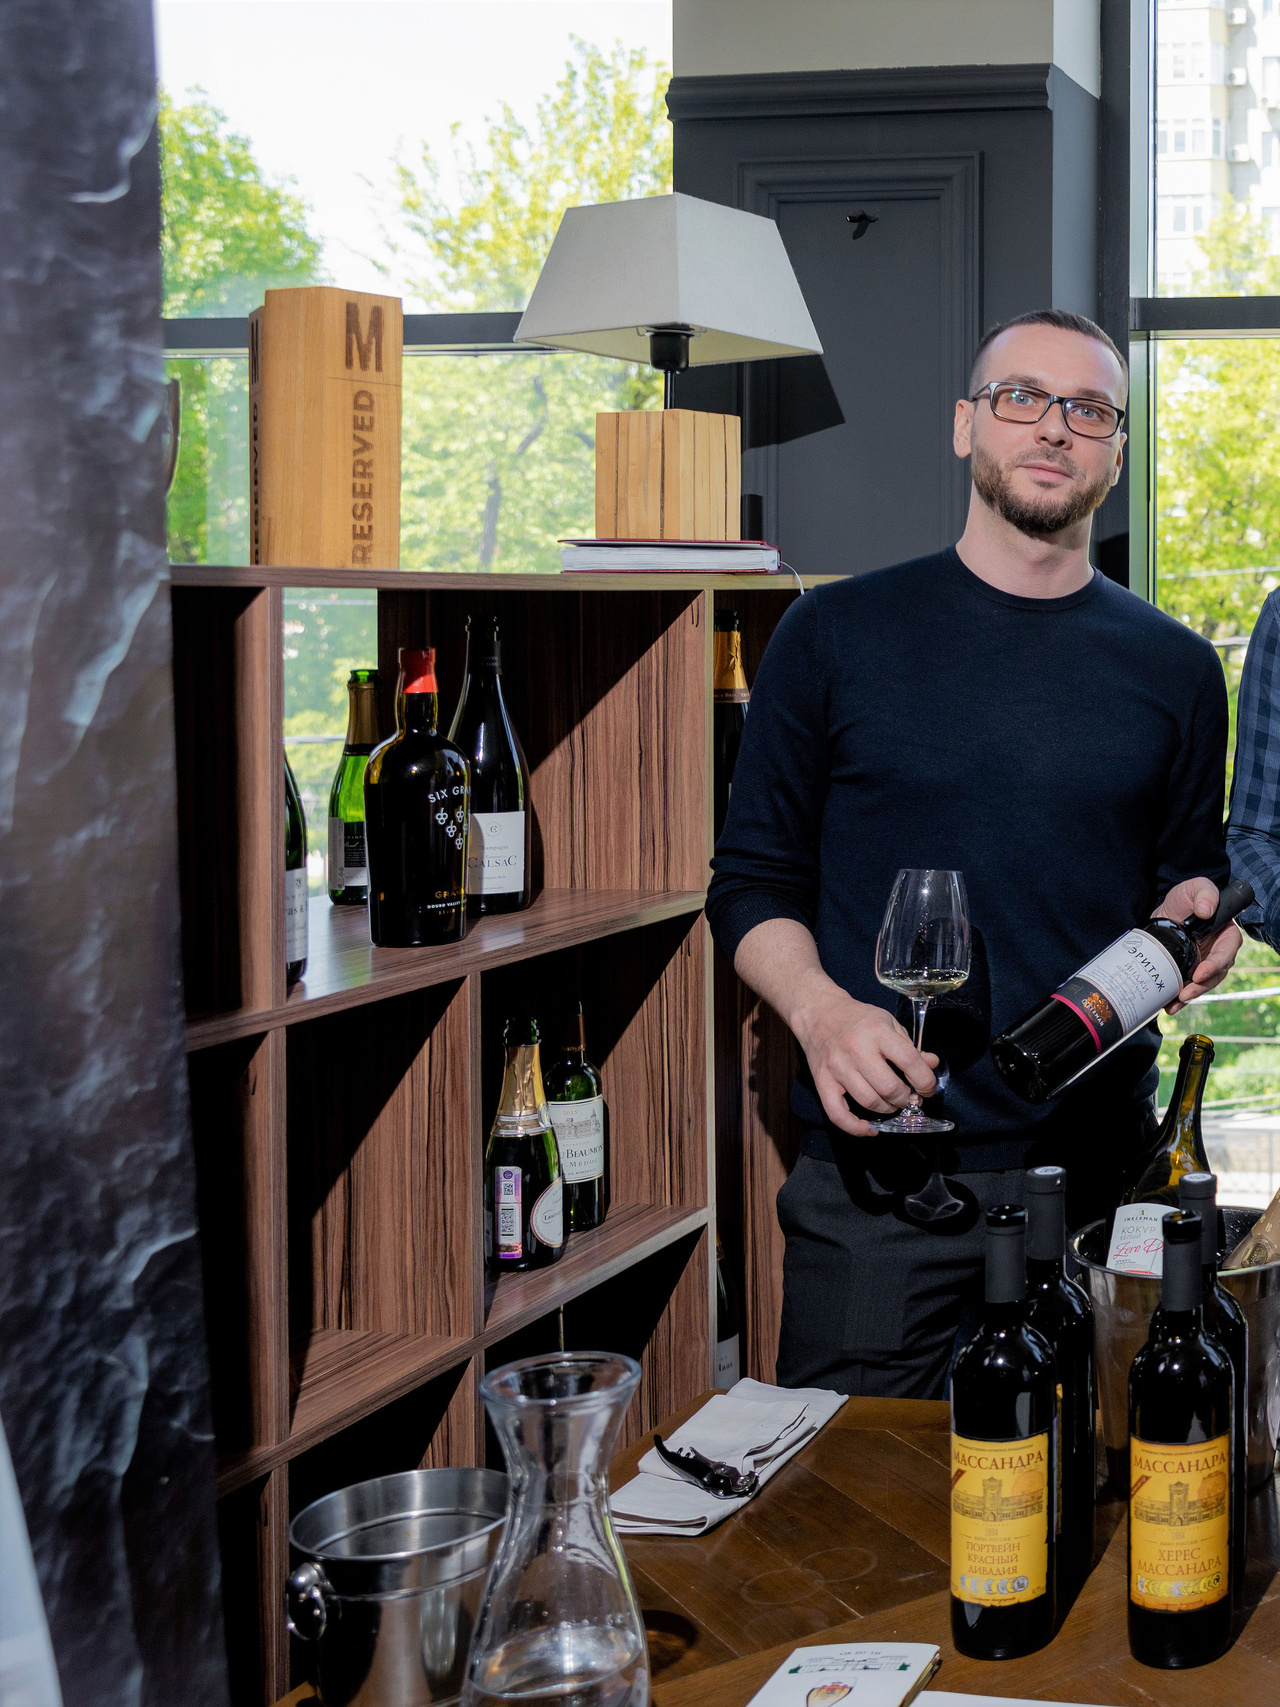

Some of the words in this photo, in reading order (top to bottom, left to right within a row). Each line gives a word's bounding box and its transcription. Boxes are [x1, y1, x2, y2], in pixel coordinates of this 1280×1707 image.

[345, 301, 384, 373] M
[351, 389, 375, 565] RESERVED
[427, 789, 448, 803] SIX
[1124, 962, 1149, 993] ИНДЖИ
[1127, 946, 1165, 992] ЭРИТАЖ
[1121, 1225, 1156, 1234] КОКУР
[1112, 1241, 1142, 1260] Zero
[953, 1448, 1044, 1470] МАССАНДРА
[1134, 1451, 1226, 1474] МАССАНДРА
[966, 1541, 1021, 1553] ПОРТВЕЙН
[1158, 1547, 1201, 1561] ХЕРЕС
[967, 1552, 1019, 1565] КРАСНЫЙ
[1137, 1555, 1222, 1577] МАССАНДРА
[968, 1565, 1018, 1576] ЛИВАДИЯ
